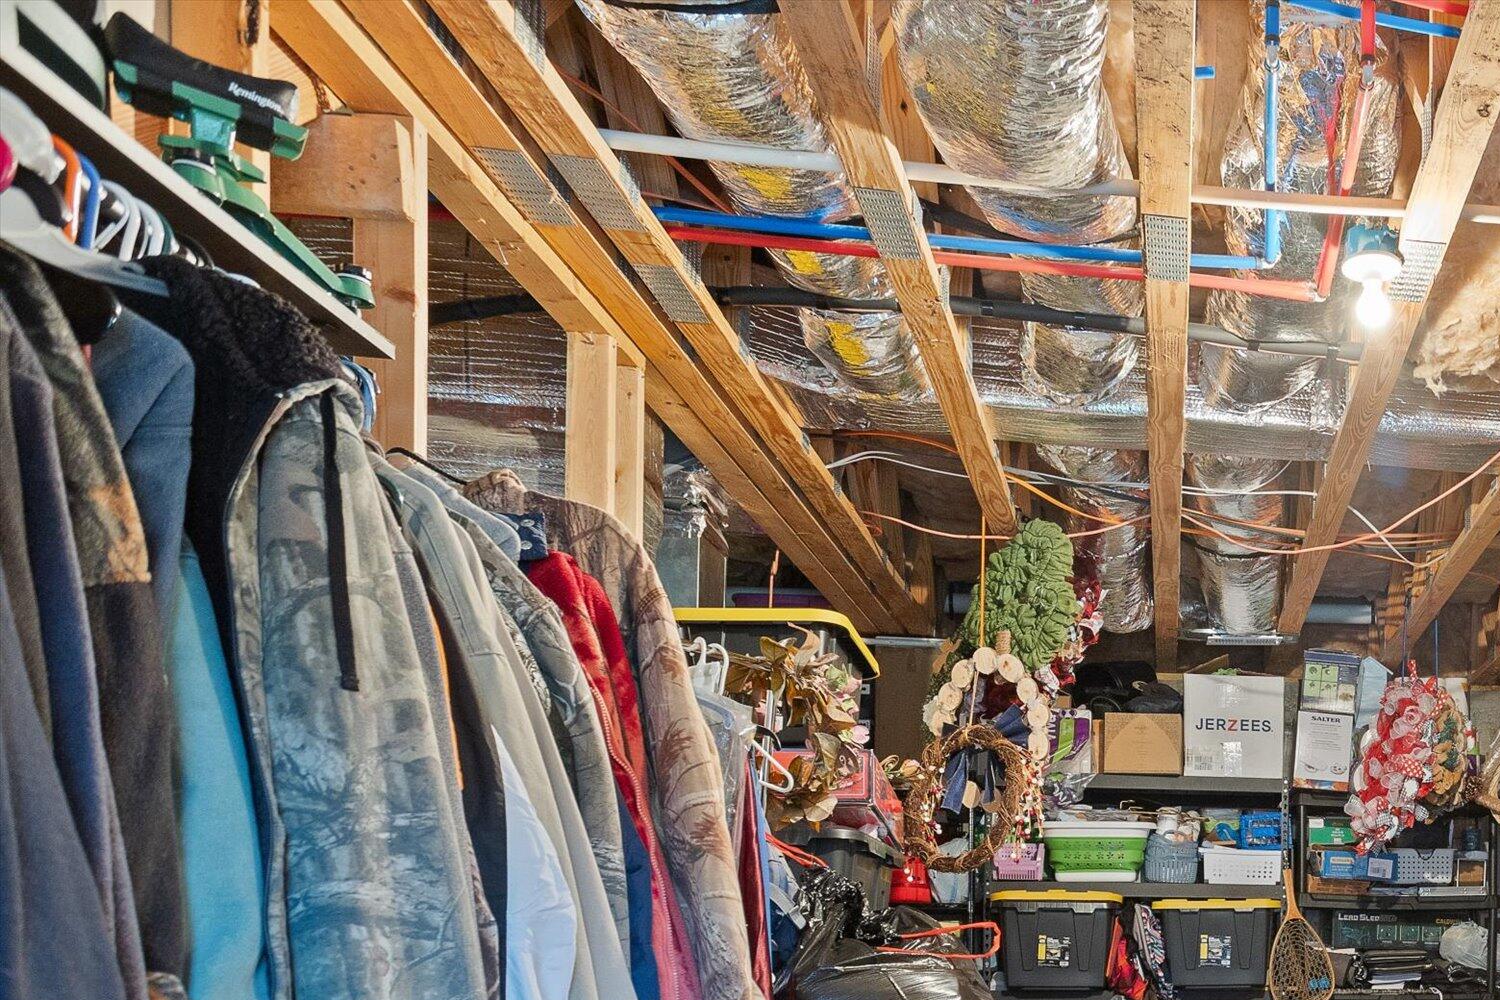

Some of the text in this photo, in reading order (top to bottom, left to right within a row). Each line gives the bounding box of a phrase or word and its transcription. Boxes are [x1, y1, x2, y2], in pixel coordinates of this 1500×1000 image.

[228, 81, 282, 112] Remington
[1195, 717, 1272, 733] JERZEES
[1311, 715, 1341, 723] SALTER
[1338, 912, 1359, 921] LEAD
[1360, 912, 1380, 922] SLED
